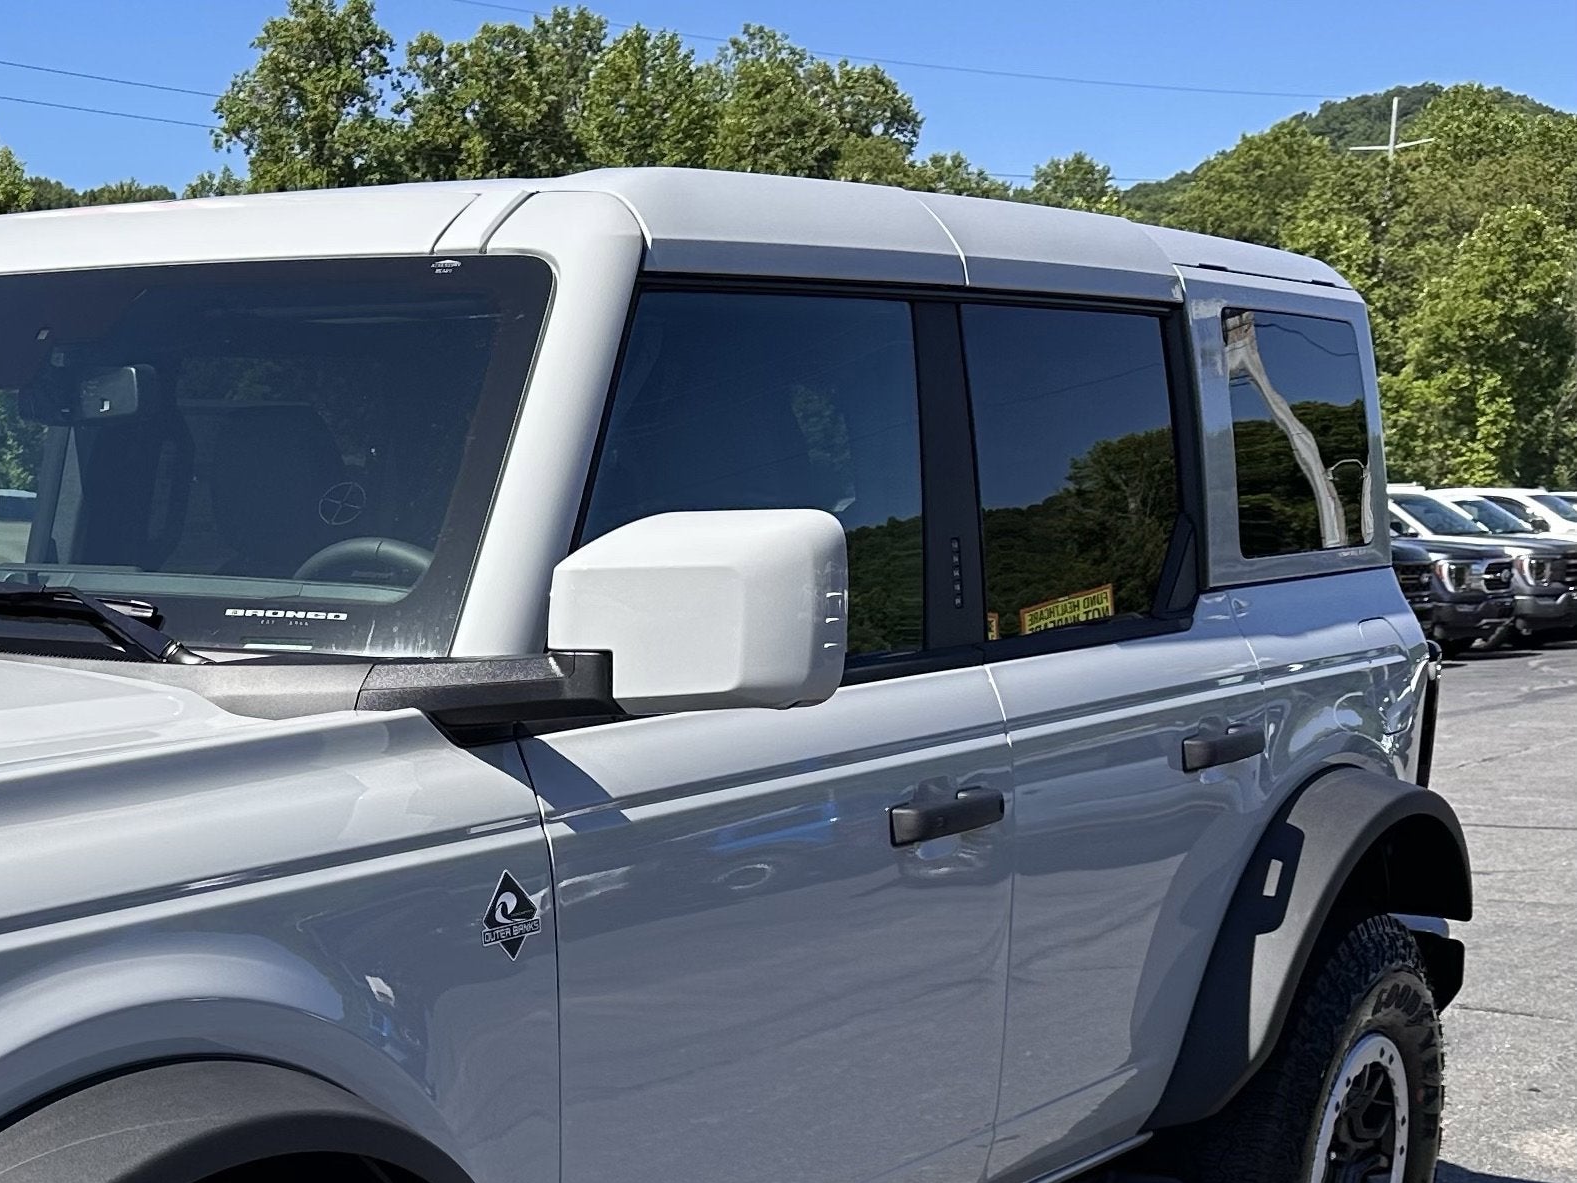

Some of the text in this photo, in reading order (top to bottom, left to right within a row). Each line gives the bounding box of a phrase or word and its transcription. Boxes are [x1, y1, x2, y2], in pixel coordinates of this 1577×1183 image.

[224, 608, 348, 620] BRONCO
[484, 920, 540, 943] OUTER BANKS
